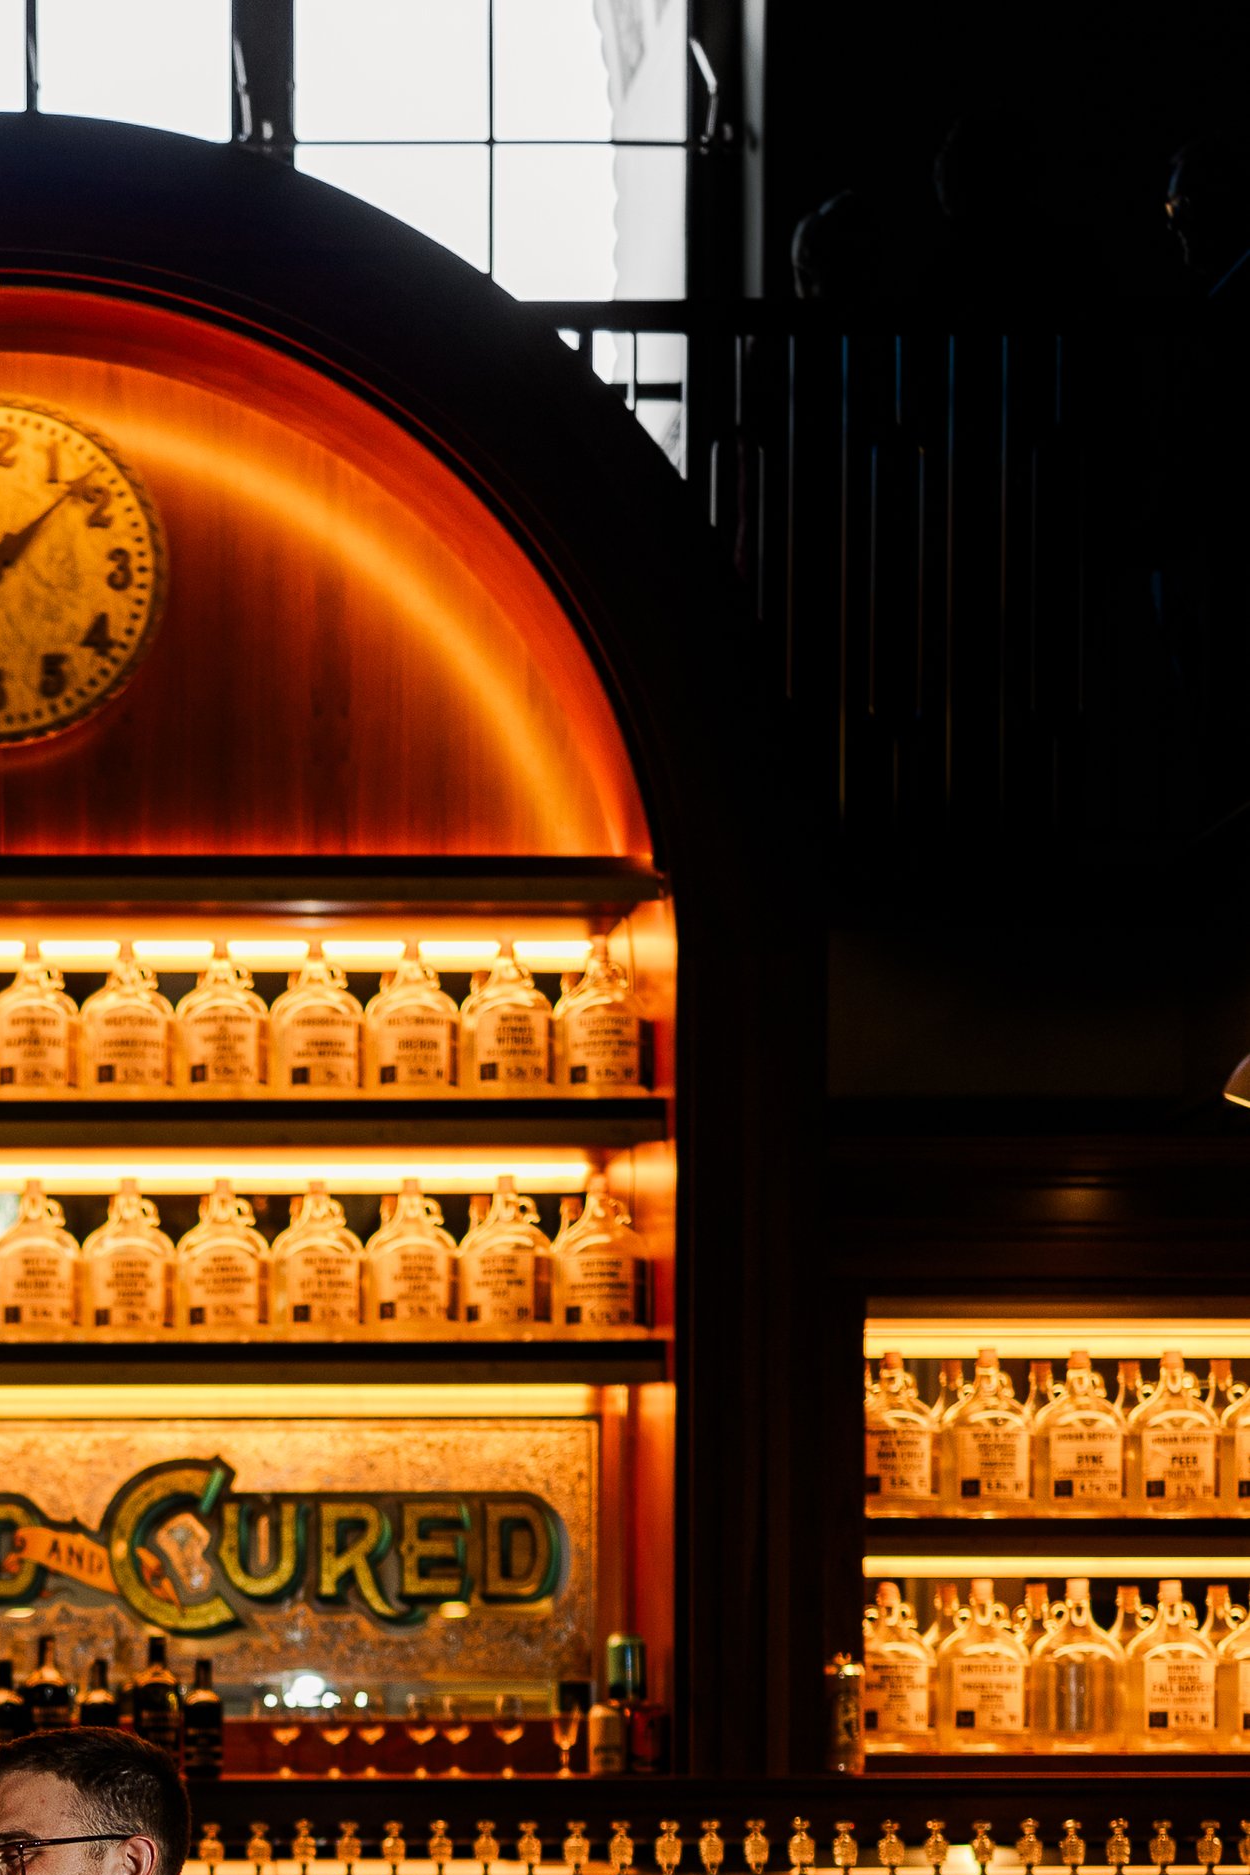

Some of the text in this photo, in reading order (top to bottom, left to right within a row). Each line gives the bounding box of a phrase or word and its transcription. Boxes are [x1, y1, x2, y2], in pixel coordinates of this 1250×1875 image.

[45, 441, 60, 484] 1
[77, 486, 112, 528] 2
[106, 548, 134, 591] 3
[80, 612, 116, 655] 4
[40, 652, 68, 698] 5
[48, 1539, 104, 1576] AND
[107, 1456, 564, 1637] CURED
